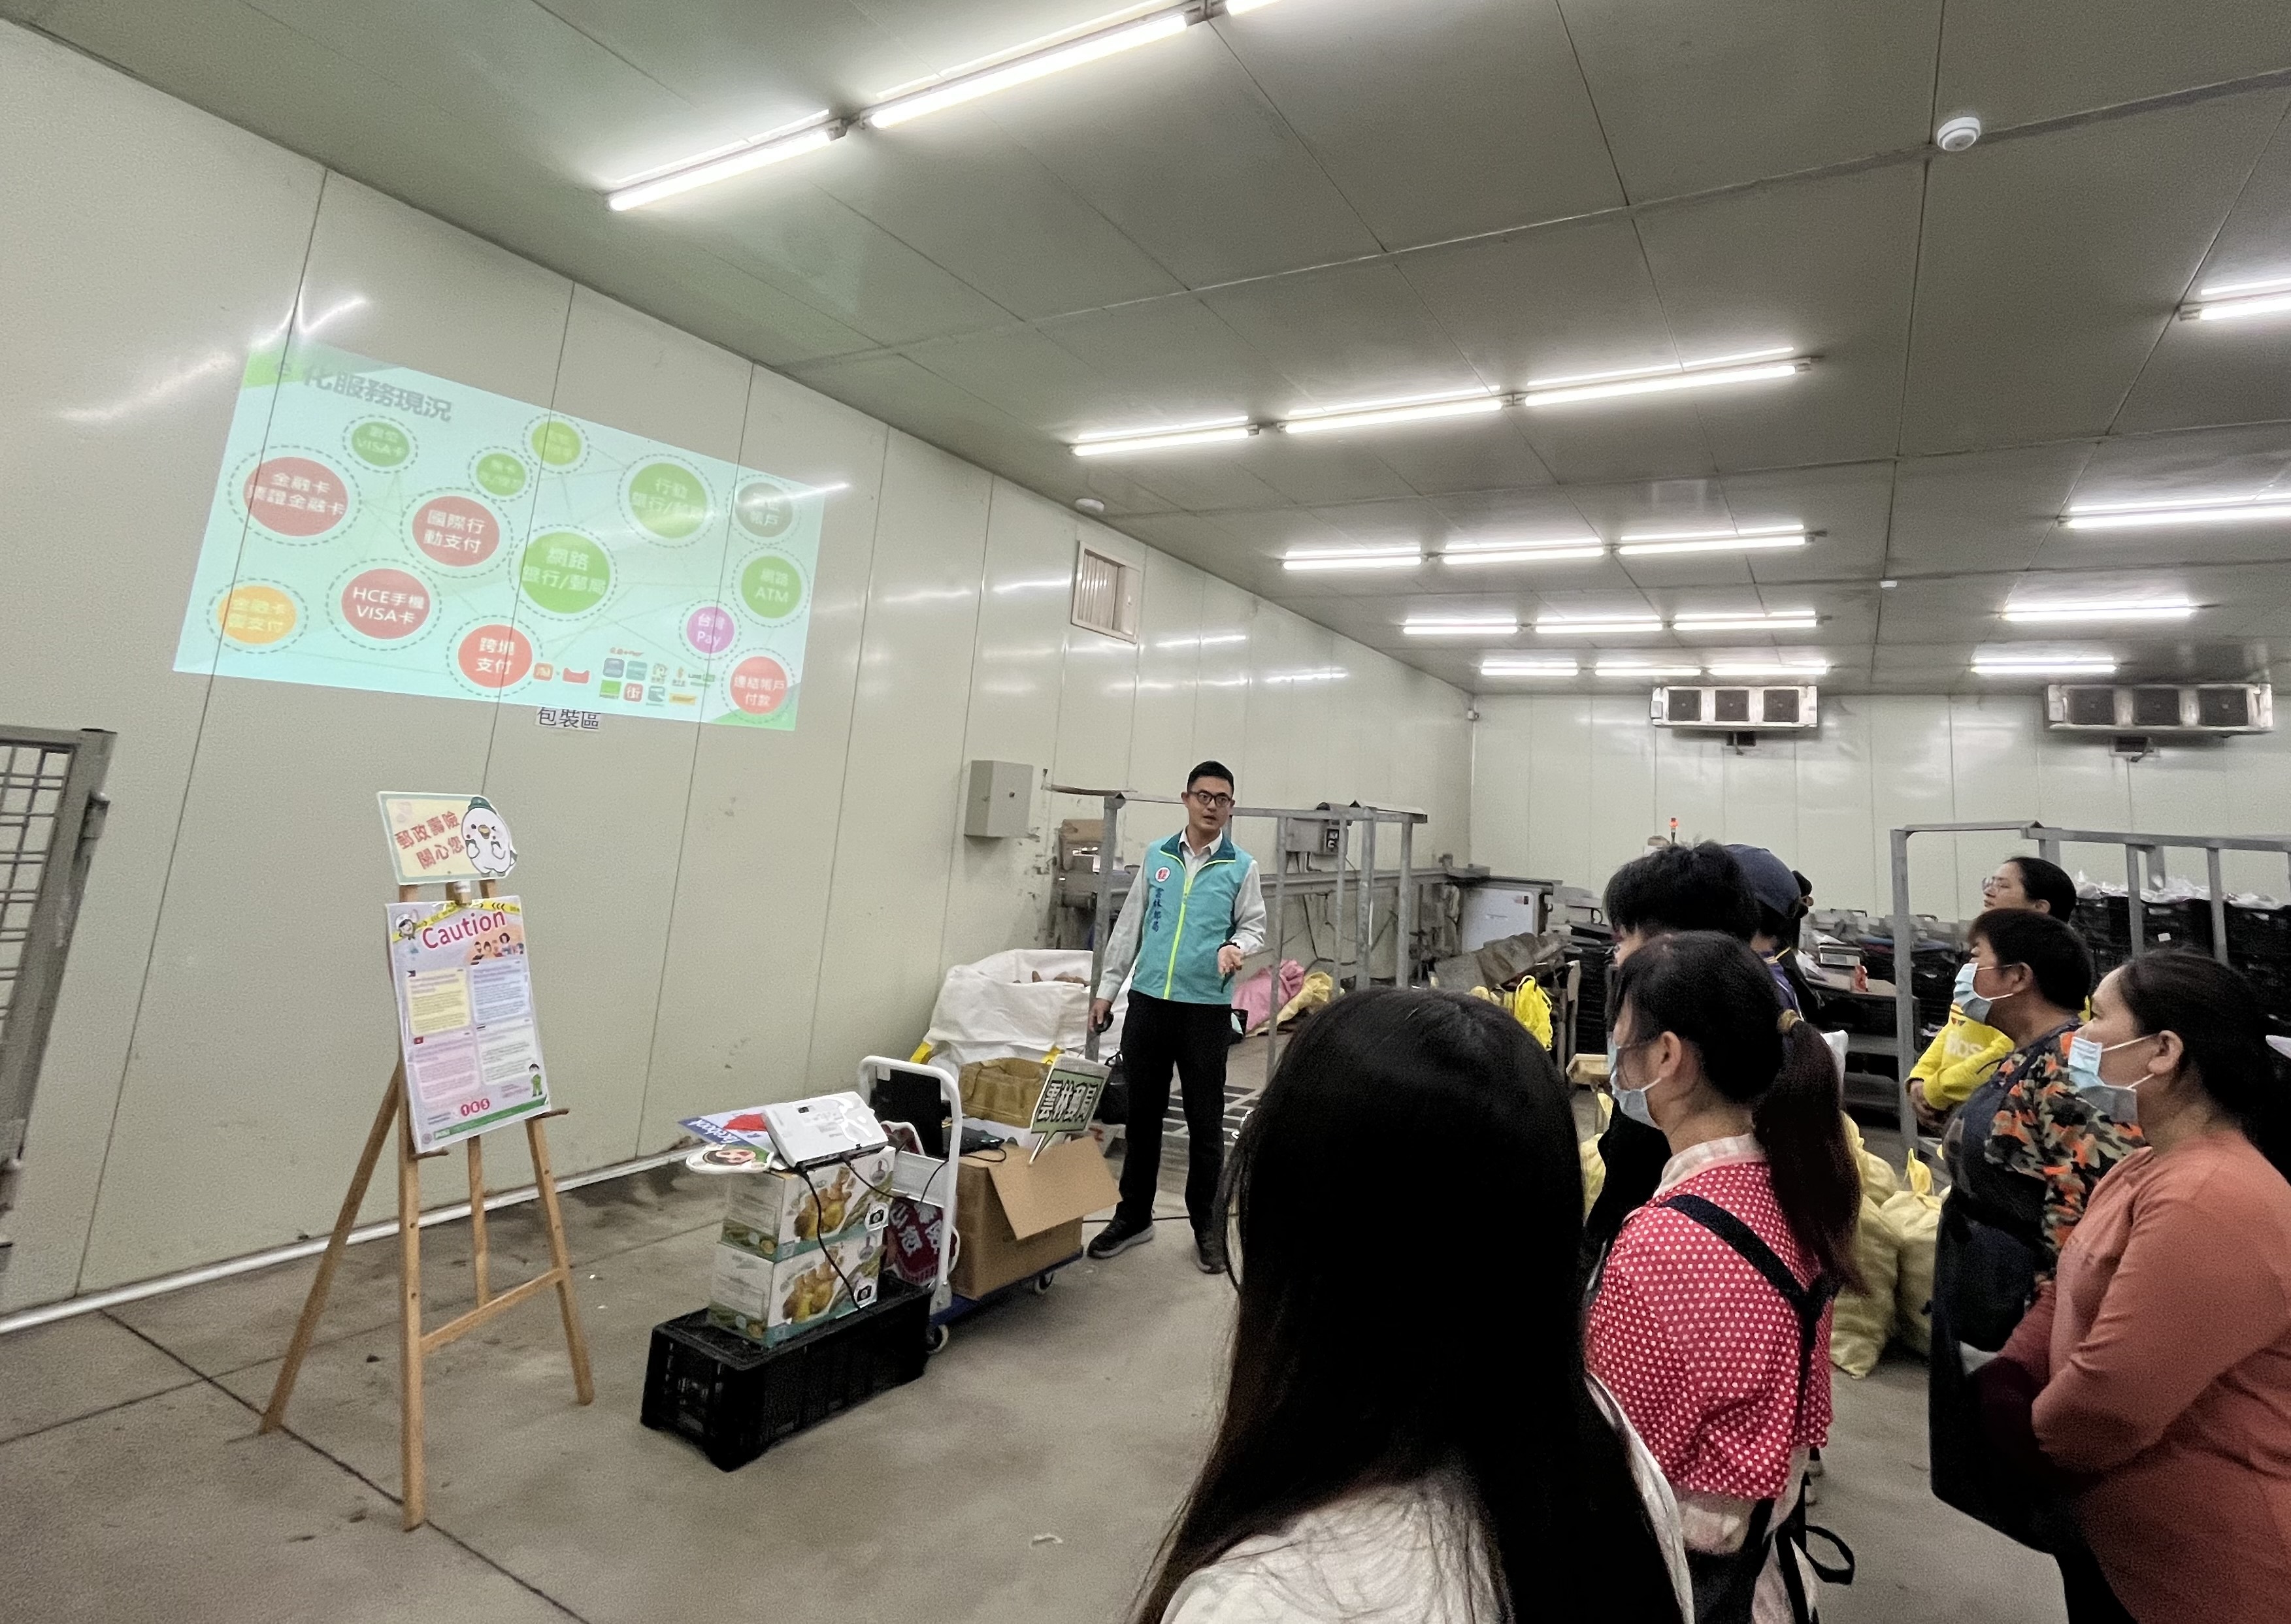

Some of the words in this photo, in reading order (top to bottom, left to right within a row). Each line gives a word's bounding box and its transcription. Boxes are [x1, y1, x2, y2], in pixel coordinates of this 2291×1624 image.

[271, 472, 331, 495] 金融卡
[427, 509, 485, 535] 國際行
[423, 528, 482, 555] 動支付
[546, 547, 589, 571] 網路
[354, 587, 425, 610] HCE手機
[755, 589, 789, 603] ATM
[356, 605, 416, 625] VISA卡
[480, 638, 515, 656] 跨境
[697, 630, 722, 649] Pay
[476, 658, 512, 675] 支付
[537, 706, 601, 729] 包裝區
[395, 811, 460, 849] 郵政壽險
[416, 836, 465, 869] 關心您
[422, 911, 505, 949] Caution
